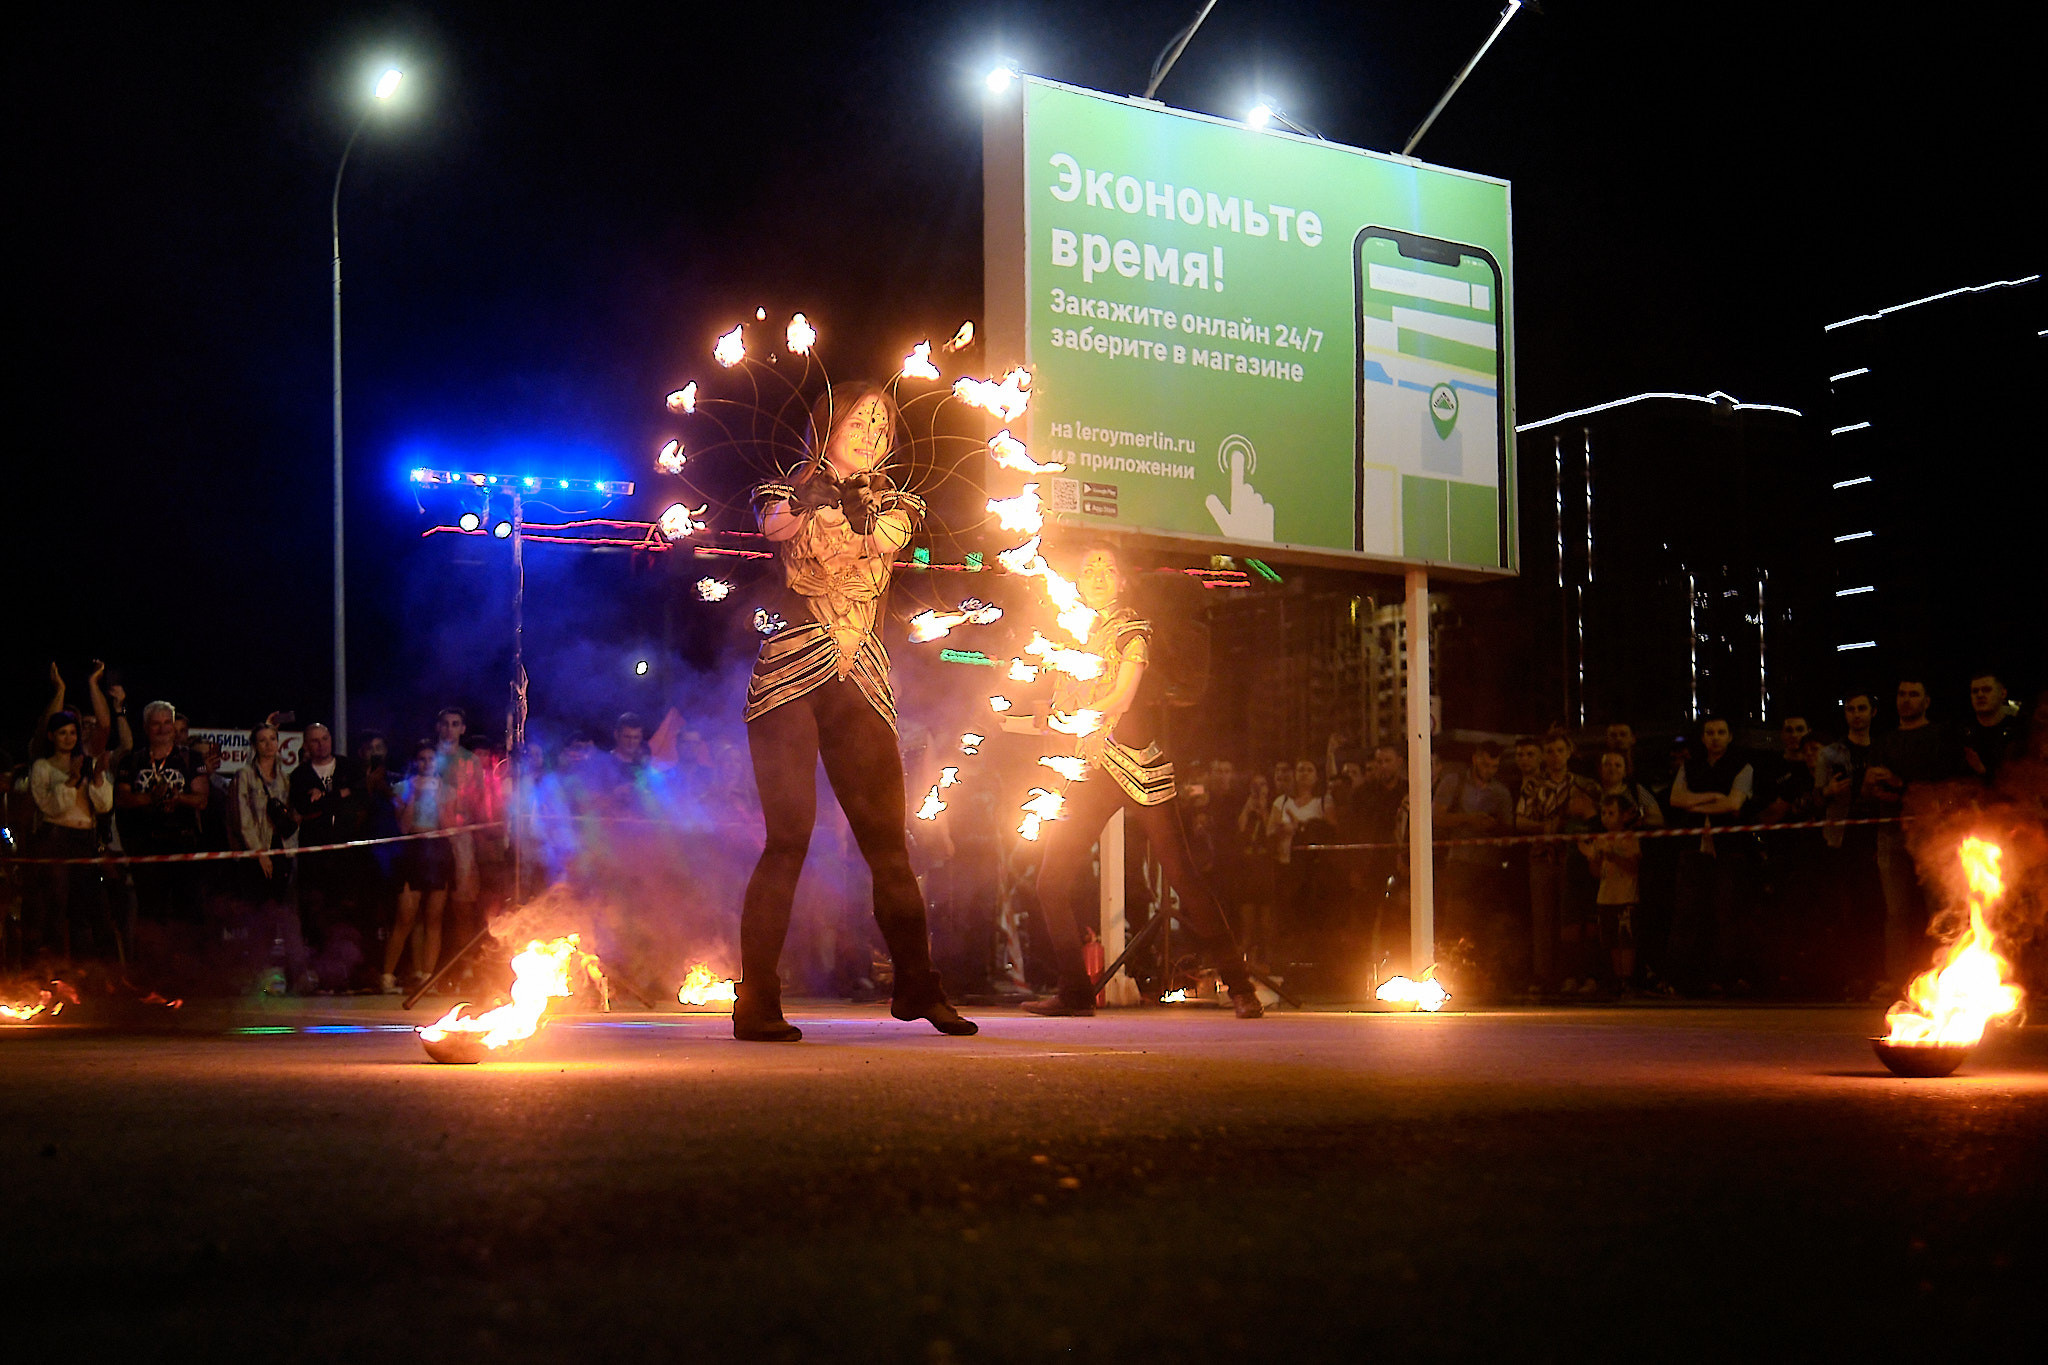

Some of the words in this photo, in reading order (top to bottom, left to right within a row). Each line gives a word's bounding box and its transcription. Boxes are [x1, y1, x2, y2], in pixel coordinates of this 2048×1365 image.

[1049, 152, 1323, 247] Экономьте
[1051, 228, 1224, 293] время!
[1050, 287, 1177, 330] Закажите
[1182, 313, 1270, 346] онлайн
[1275, 323, 1324, 353] 24/7
[1050, 325, 1168, 361] заберите
[1173, 345, 1186, 365] в
[1192, 347, 1304, 382] магазине
[1051, 422, 1073, 439] на
[1076, 420, 1196, 454] leroymerlin.ru
[1066, 450, 1076, 465] в
[1080, 452, 1196, 480] приложении
